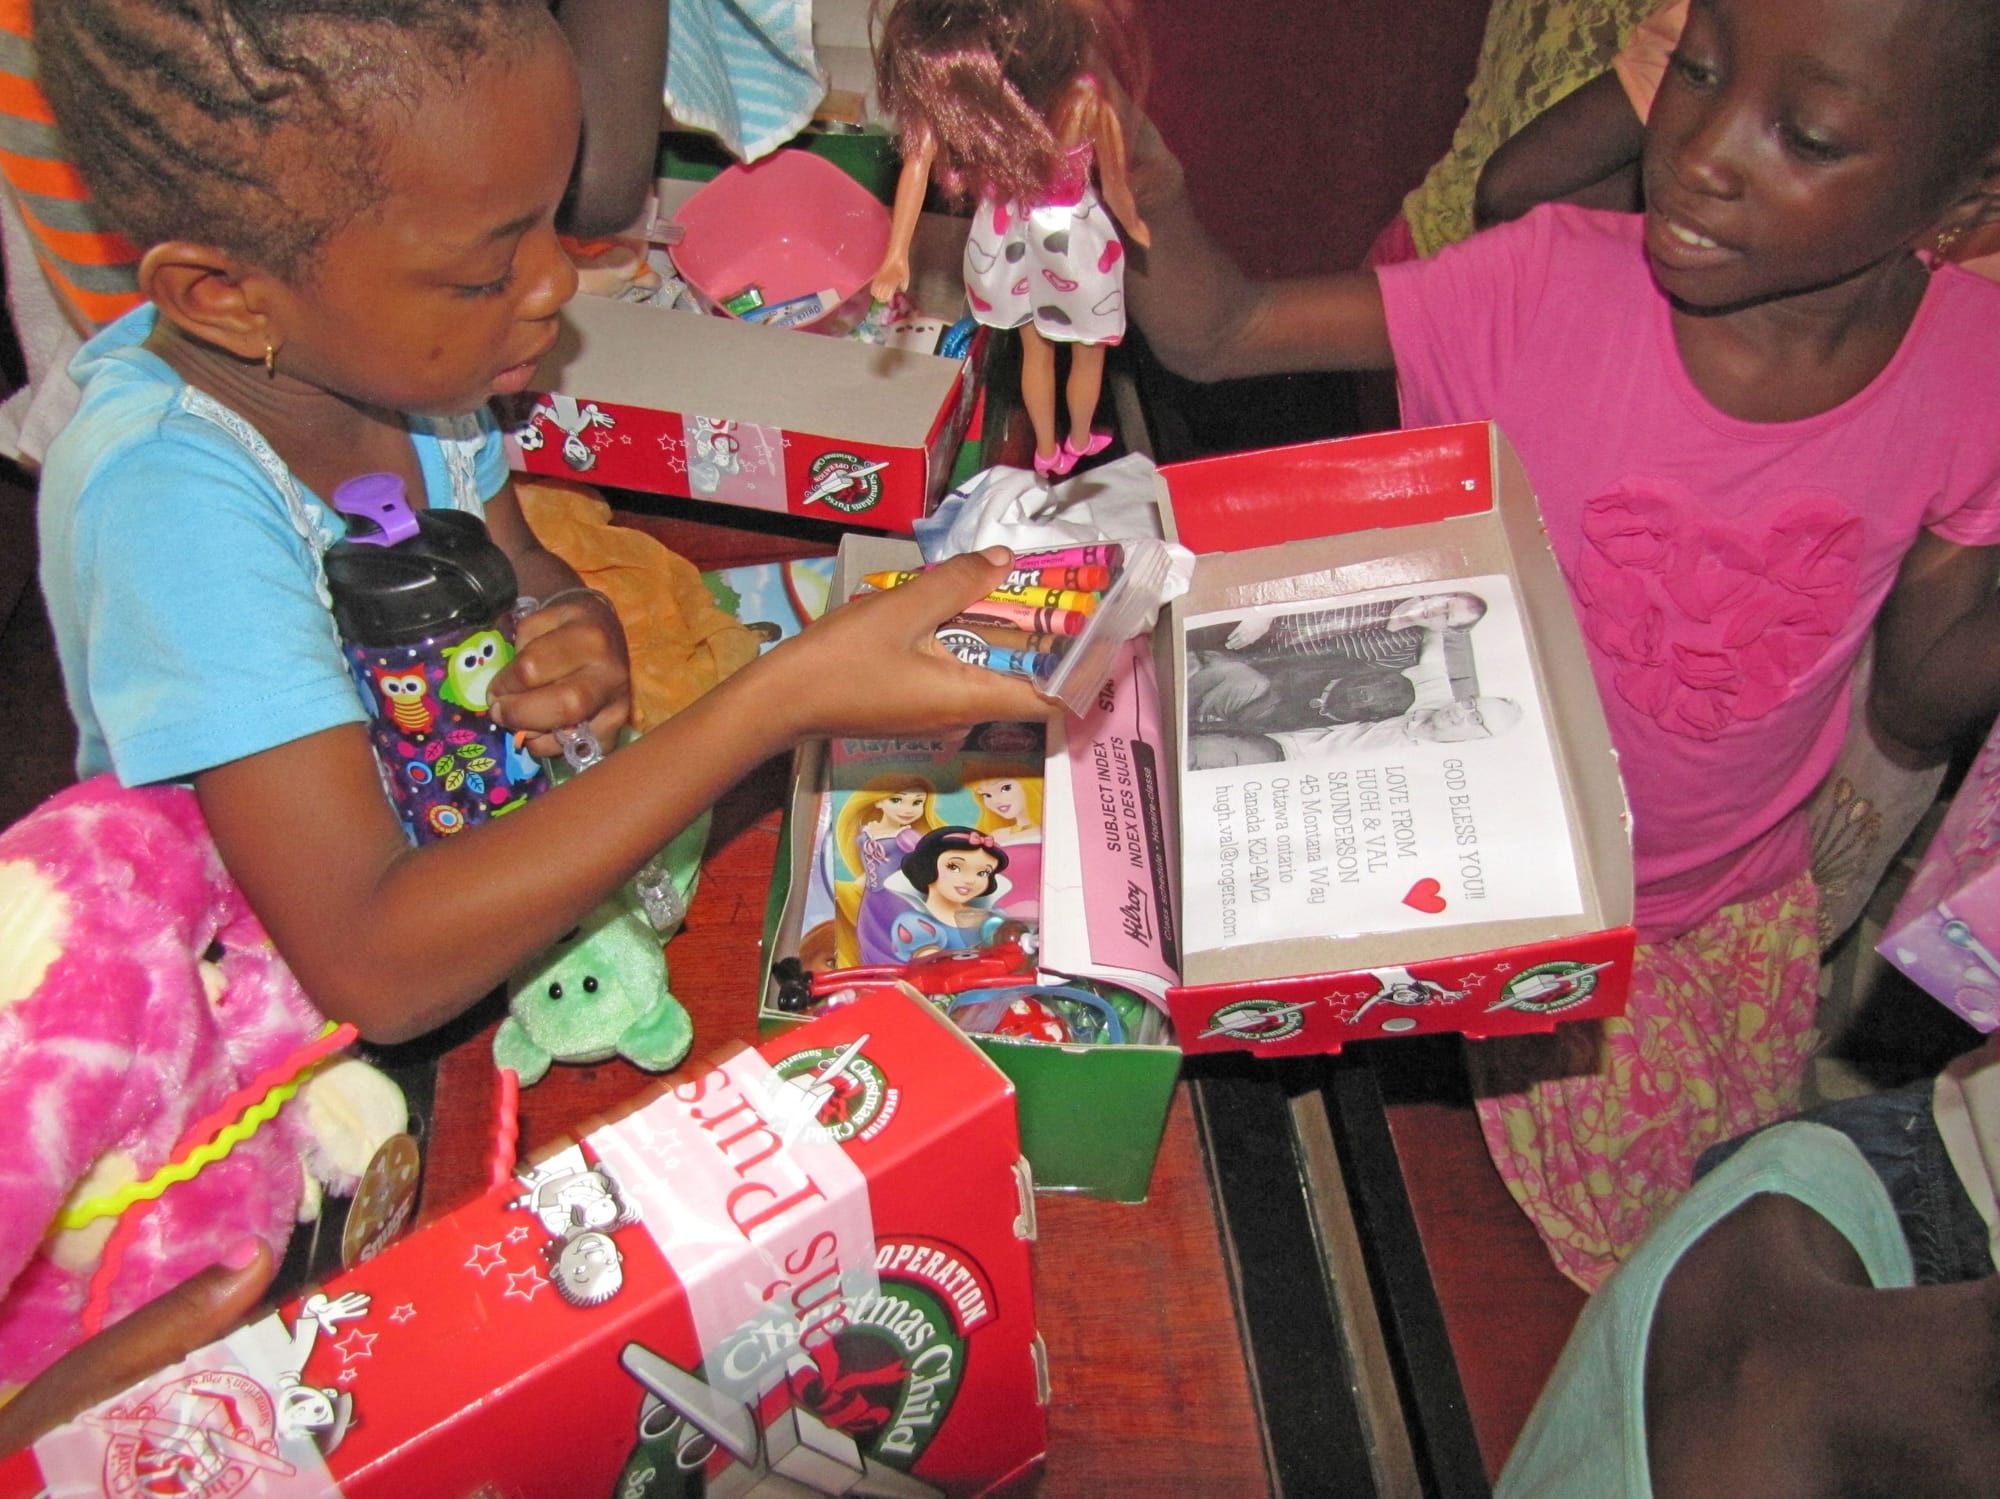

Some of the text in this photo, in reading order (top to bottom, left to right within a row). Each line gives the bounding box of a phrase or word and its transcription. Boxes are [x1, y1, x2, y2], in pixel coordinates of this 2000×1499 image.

[825, 495, 851, 512] Purse
[1007, 569, 1041, 587] Art
[1099, 679, 1115, 713] STA
[1093, 741, 1121, 852] SUBJECT INDEX
[1110, 736, 1143, 868] INDEX DES SUJETS
[1243, 781, 1271, 904] Canada K2J4M2
[1271, 777, 1297, 884] Ottawa ontario
[1300, 774, 1330, 904] 45 Montana Way
[1328, 771, 1360, 884] SAUNDERSON
[1356, 768, 1388, 874] HUGH & VAL
[1385, 765, 1418, 859] LOVE FROM
[1443, 758, 1486, 900] GOD BLESS YOU!!
[1120, 880, 1152, 948] Hilroy
[1213, 784, 1239, 939] hugh.val@rogers.com
[851, 1059, 882, 1124] Christmas
[860, 1088, 898, 1142] OPERATION
[673, 1068, 827, 1242] Purs
[874, 1244, 988, 1327] OPERATION
[723, 1288, 953, 1455] Christmas Child
